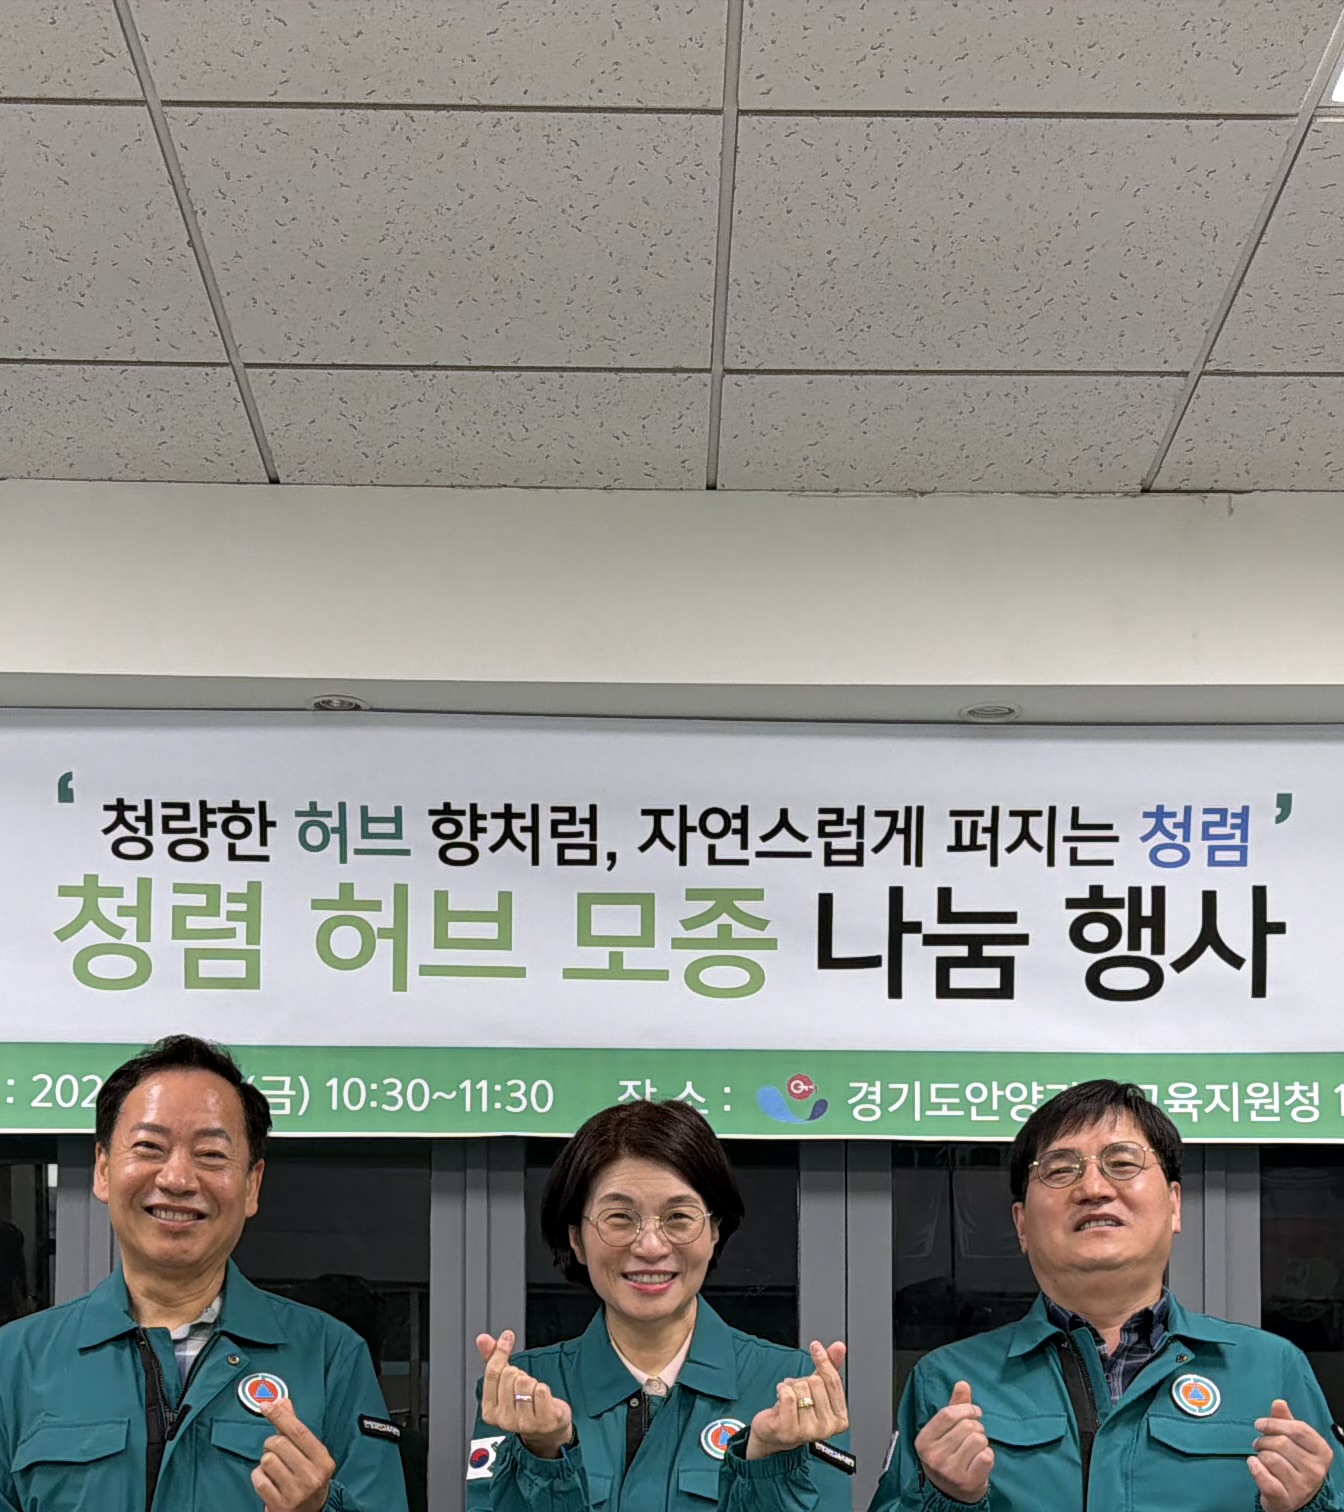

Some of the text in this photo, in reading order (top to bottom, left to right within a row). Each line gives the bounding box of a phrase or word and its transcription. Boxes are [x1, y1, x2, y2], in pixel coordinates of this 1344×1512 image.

[101, 798, 277, 862] 청량한
[295, 801, 411, 862] 허브
[428, 802, 616, 872] 향처럼,
[638, 804, 924, 867] 자연스럽게
[947, 806, 1119, 867] 퍼지는
[1140, 805, 1250, 868] 청렴
[54, 875, 1286, 1002] 청렴 허브 모종 나눔 행사
[30, 1073, 103, 1108] 202
[326, 1077, 554, 1113] 10:30~11:30
